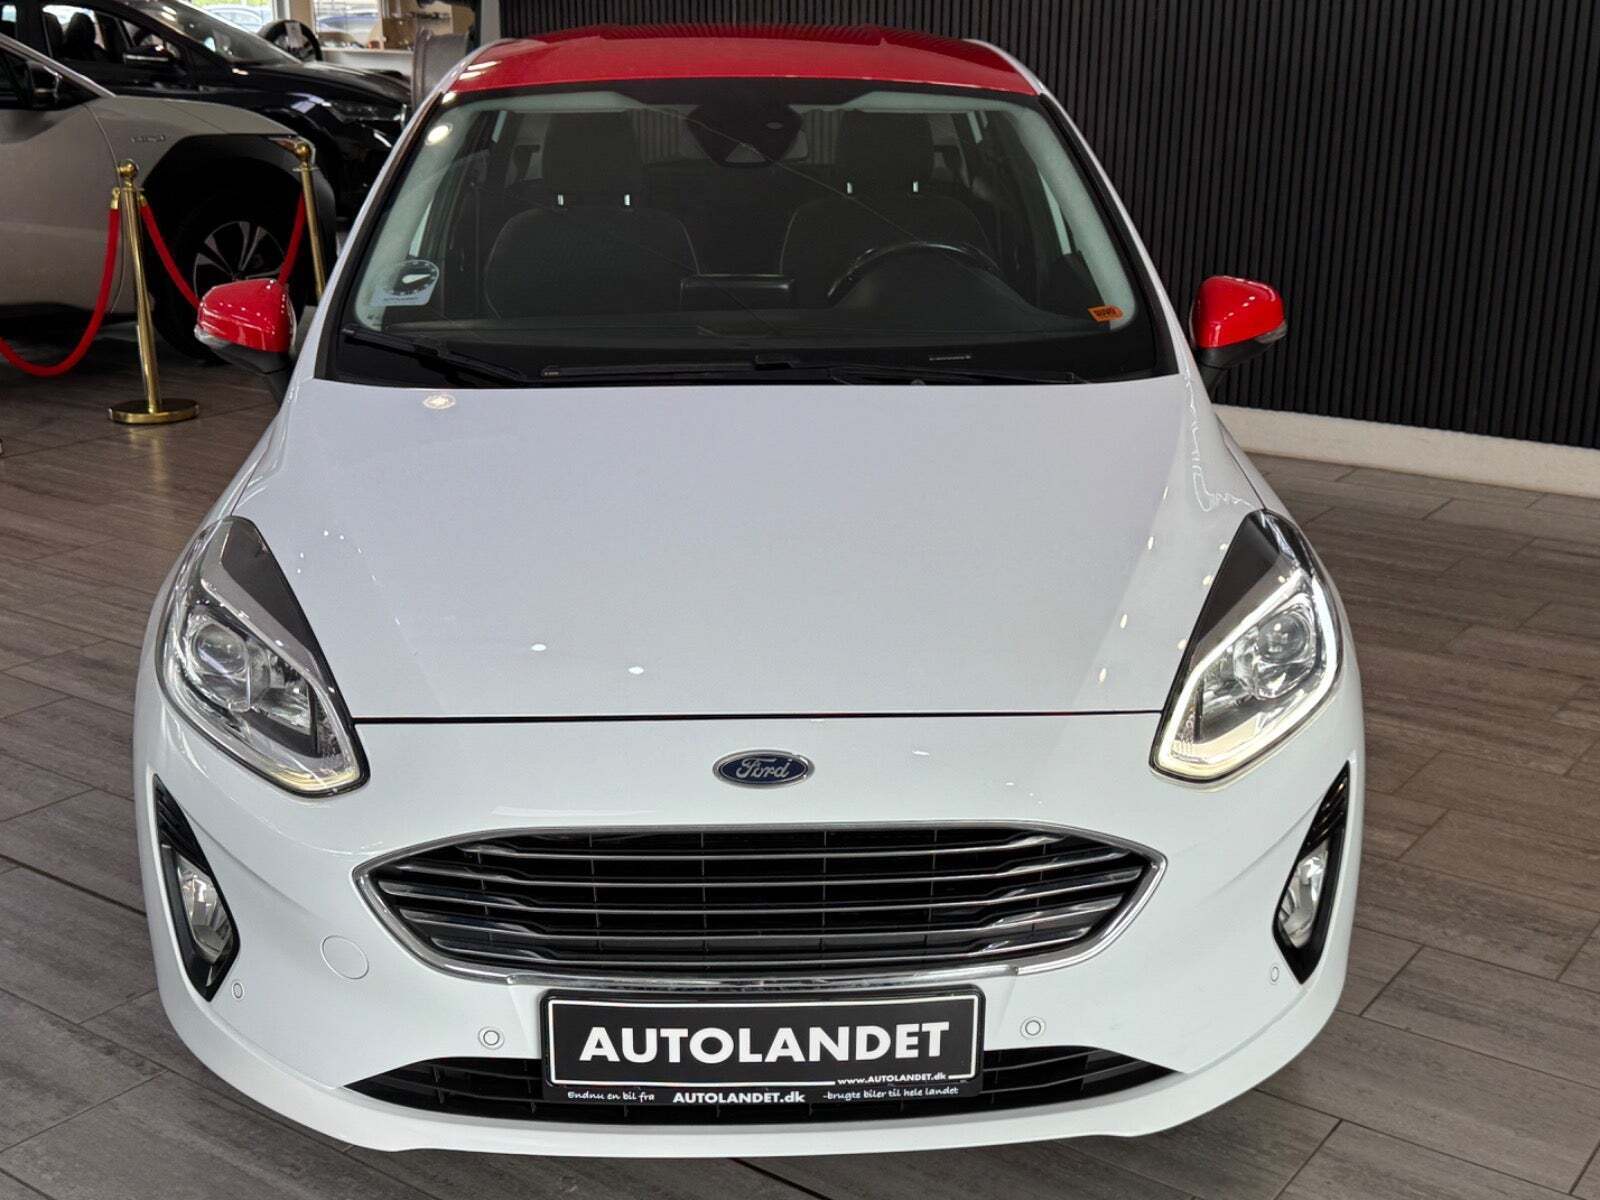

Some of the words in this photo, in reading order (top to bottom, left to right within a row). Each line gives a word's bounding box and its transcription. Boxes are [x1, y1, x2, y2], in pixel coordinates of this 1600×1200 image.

[735, 757, 793, 779] Ford
[579, 1022, 950, 1064] AUTOLANDET
[837, 1072, 947, 1085] www.AUTOLANDET.dk
[567, 1090, 604, 1100] Endnu
[606, 1092, 620, 1100] en
[622, 1090, 637, 1100] bil
[639, 1091, 655, 1103] fra
[672, 1091, 806, 1104] AUTOLANDET.dk
[863, 1088, 887, 1099] biler
[888, 1087, 901, 1098] til
[903, 1087, 923, 1097] hele
[925, 1086, 959, 1096] landet
